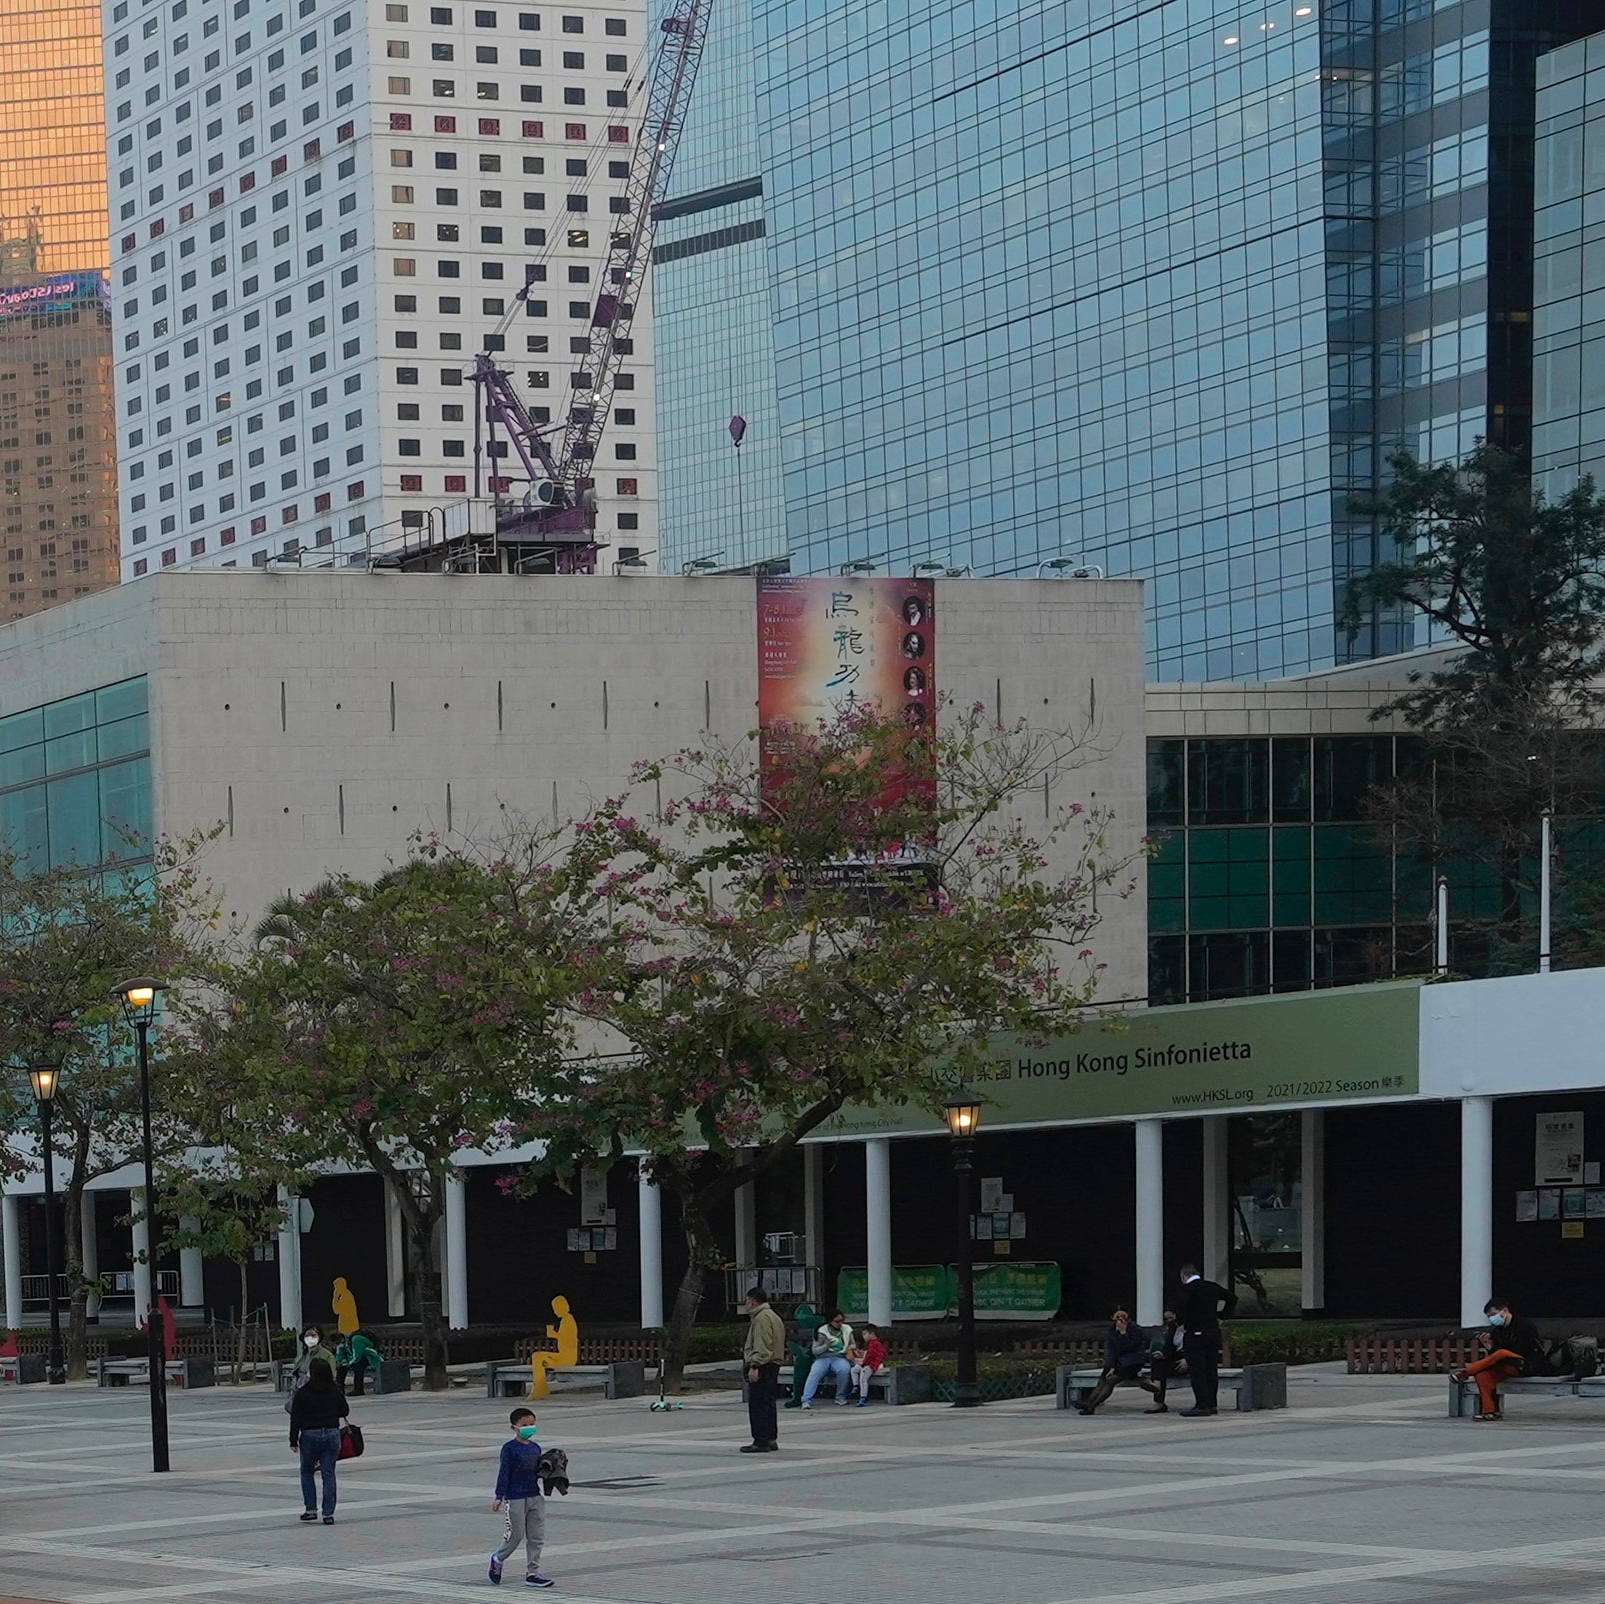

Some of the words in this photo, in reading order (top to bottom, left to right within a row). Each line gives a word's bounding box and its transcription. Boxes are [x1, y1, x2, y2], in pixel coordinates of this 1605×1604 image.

[1018, 1058, 1071, 1080] Hong
[1076, 1052, 1129, 1076] Kong
[1134, 1039, 1252, 1069] Sinfonietta
[1172, 1086, 1254, 1105] www.HKSL.org
[1267, 1079, 1333, 1098] 2021/2022
[1336, 1076, 1380, 1094] Season
